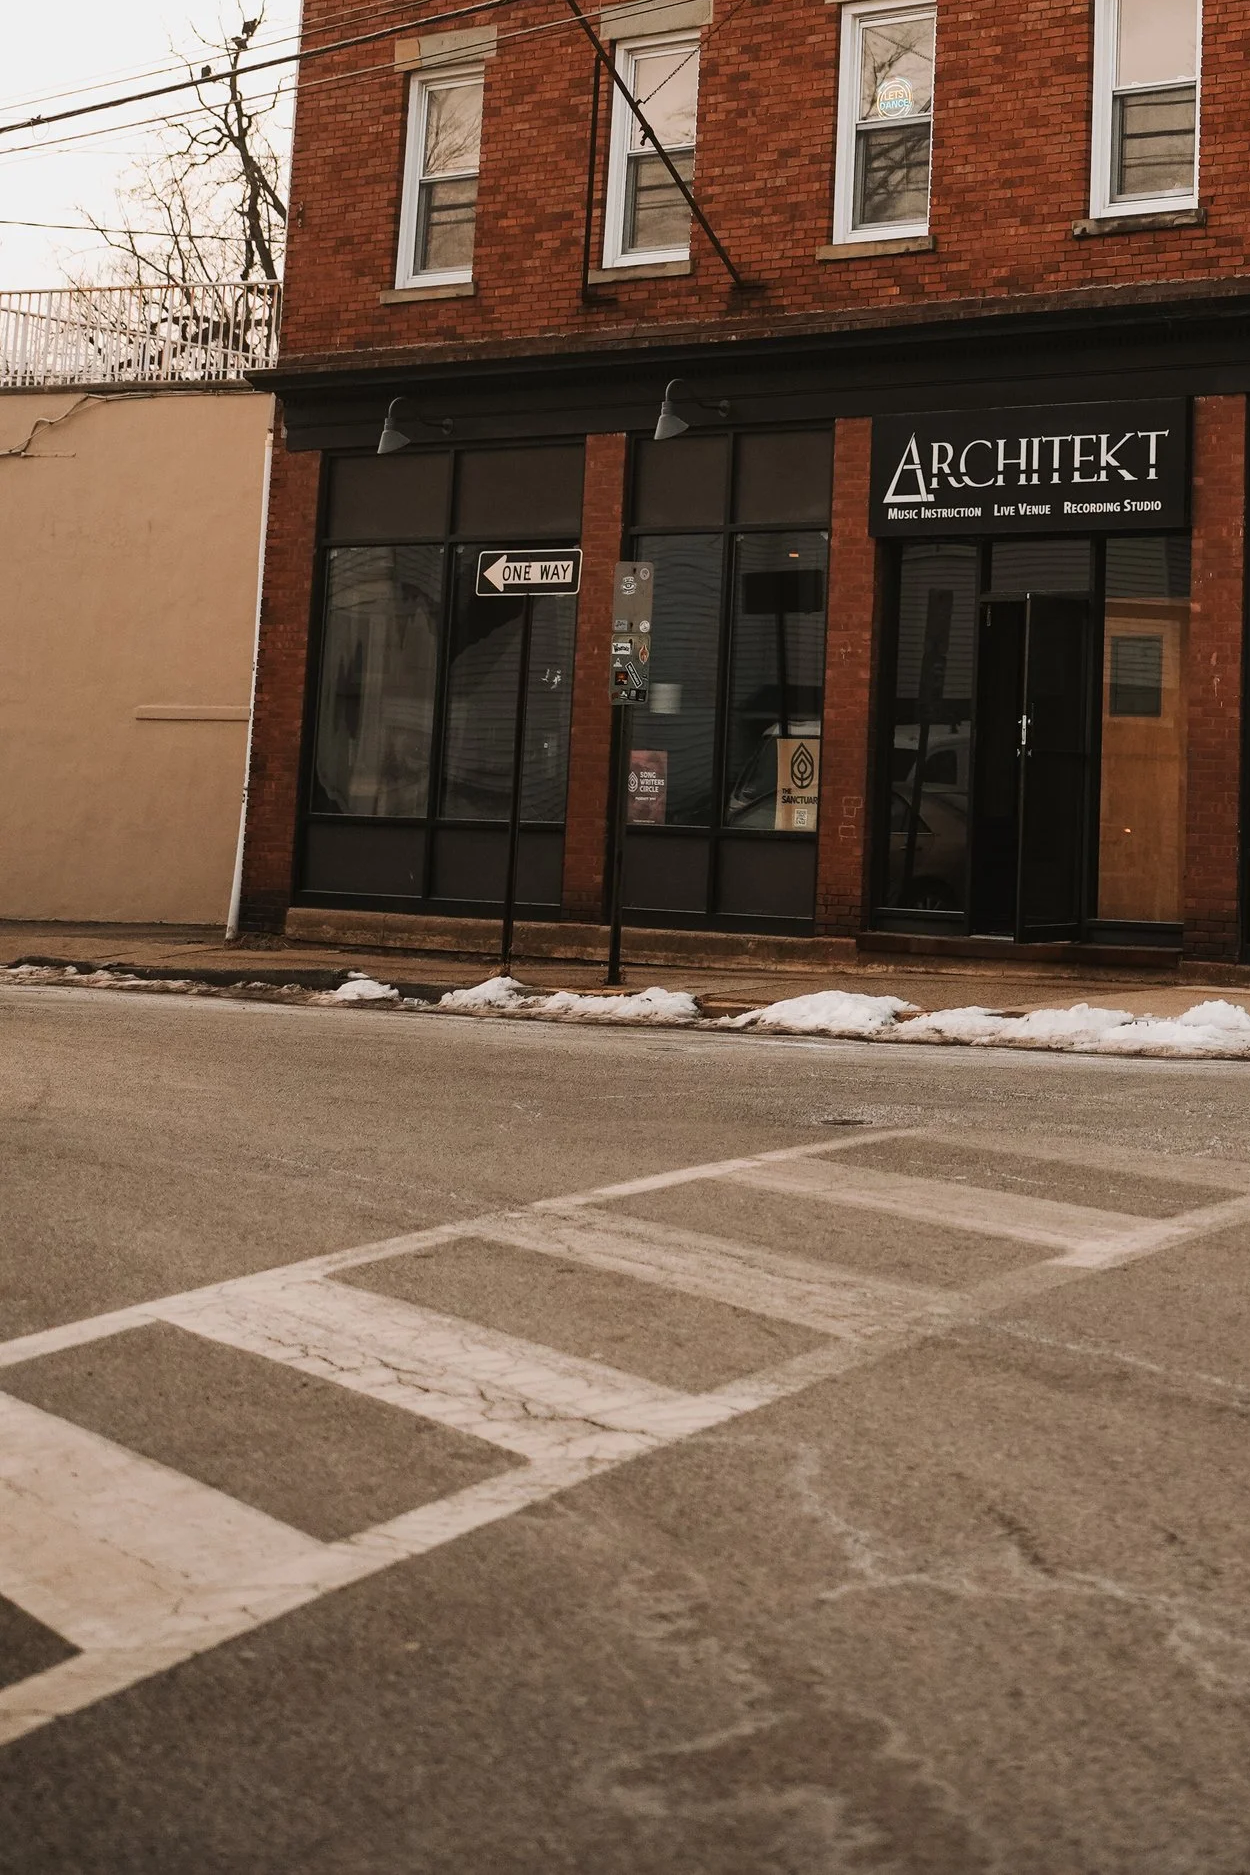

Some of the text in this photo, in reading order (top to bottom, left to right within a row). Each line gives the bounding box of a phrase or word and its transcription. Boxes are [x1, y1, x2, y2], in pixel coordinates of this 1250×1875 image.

[884, 90, 904, 101] LETS
[880, 99, 910, 111] DANCE
[883, 429, 1170, 503] ARCHITEKT
[887, 499, 1162, 520] MUSIC INSTRUCTION LIVE VENUE RECORDING STUDIO
[502, 563, 571, 582] ONE WAY
[639, 771, 657, 779] SONG
[639, 778, 665, 786] WRITERS
[639, 785, 659, 793] CIRCLE
[782, 795, 819, 804] SANCTUAR
